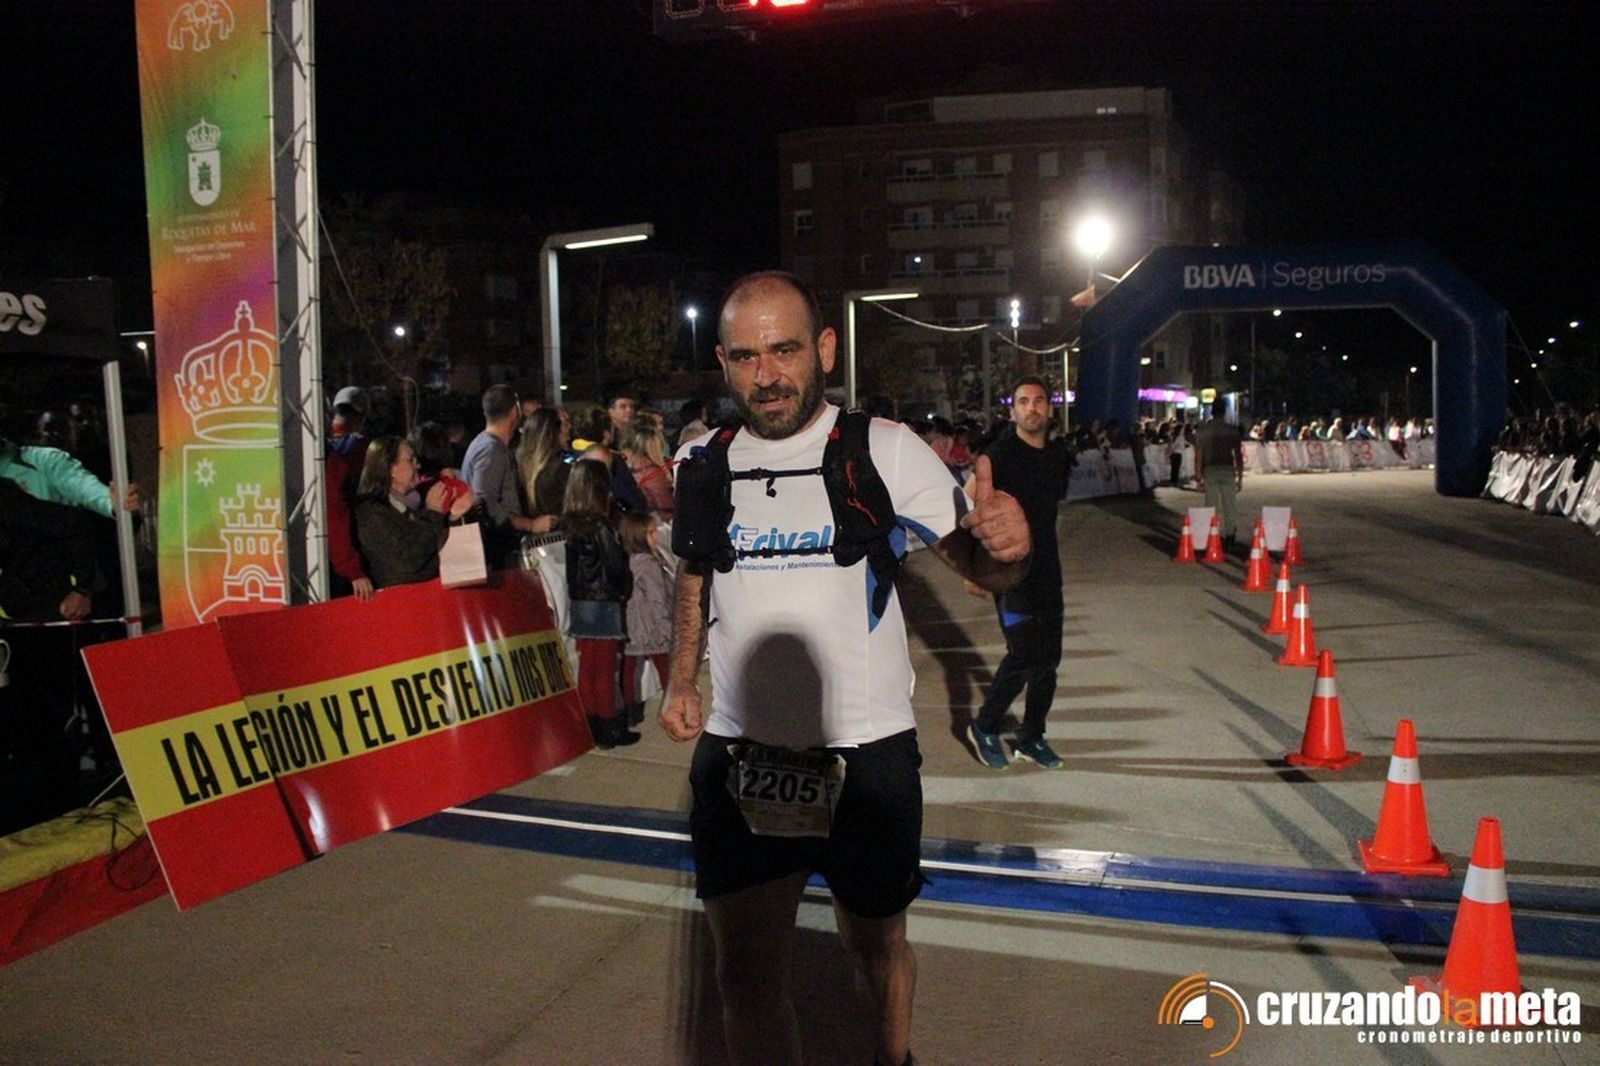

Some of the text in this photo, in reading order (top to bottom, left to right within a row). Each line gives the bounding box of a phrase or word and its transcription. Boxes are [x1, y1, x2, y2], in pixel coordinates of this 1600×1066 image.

[1184, 261, 1386, 291] BBVA Seguros
[161, 731, 222, 805] LA
[214, 693, 327, 788] LEGIÓN
[320, 695, 349, 756] Y
[349, 685, 396, 748] EL
[391, 653, 514, 737] DESIERTO
[509, 645, 546, 703] NOS
[742, 768, 820, 804] 2205
